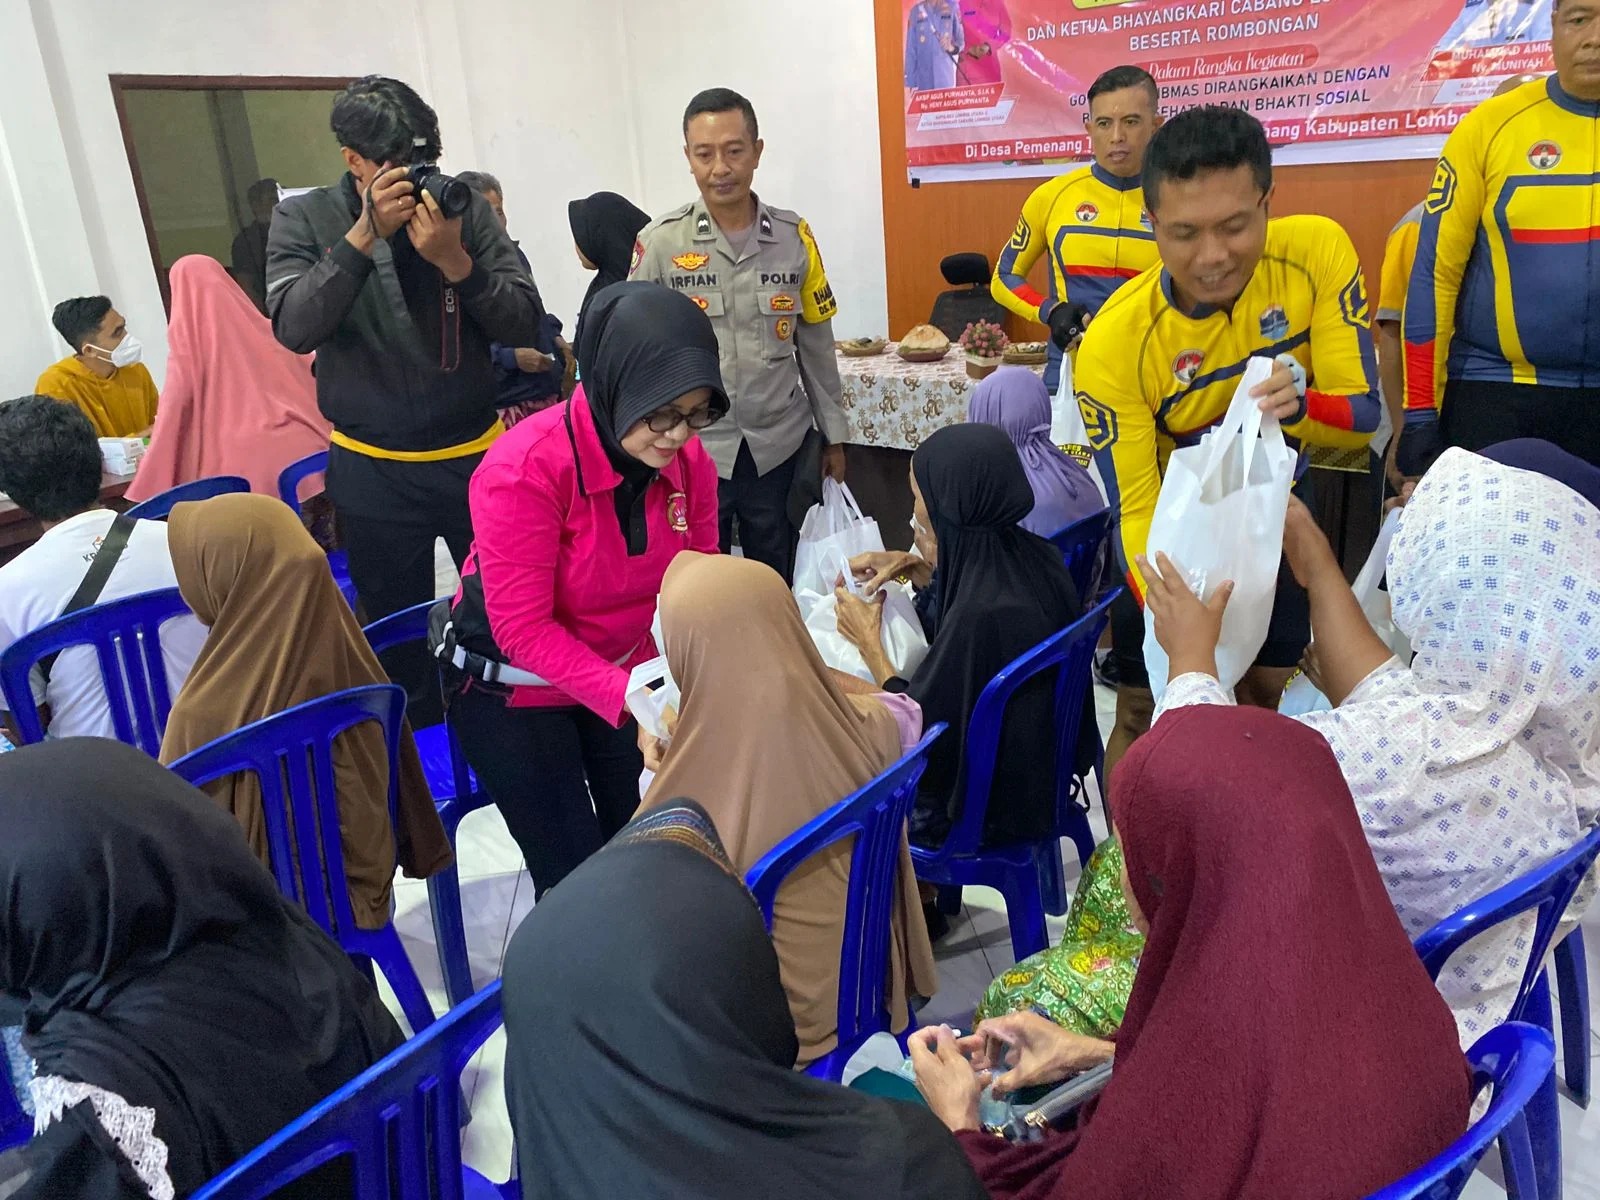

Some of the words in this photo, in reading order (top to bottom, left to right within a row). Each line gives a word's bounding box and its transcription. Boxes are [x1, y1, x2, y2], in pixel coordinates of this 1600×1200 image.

[1027, 25, 1056, 42] DAN
[1060, 17, 1108, 37] KETUA
[1112, 0, 1225, 31] BHAYANGKARI
[1129, 29, 1201, 51] BESERTA
[1206, 13, 1319, 42] ROMBONGAN
[1149, 61, 1190, 80] Dalam
[1193, 57, 1242, 75] Rangka
[1246, 52, 1304, 71] Kegiatan
[1204, 72, 1318, 95] DIRANGKAIKAN
[1323, 65, 1391, 84] DENGAN
[1255, 94, 1310, 111] BHAKTI
[1315, 89, 1371, 106] SOSIAL
[965, 144, 978, 158] Di
[981, 143, 1011, 157] Desa
[1015, 138, 1083, 155] Pemenang
[1305, 117, 1399, 137] Kabupaten
[671, 273, 718, 289] IRFIAN
[761, 273, 800, 285] POLRI
